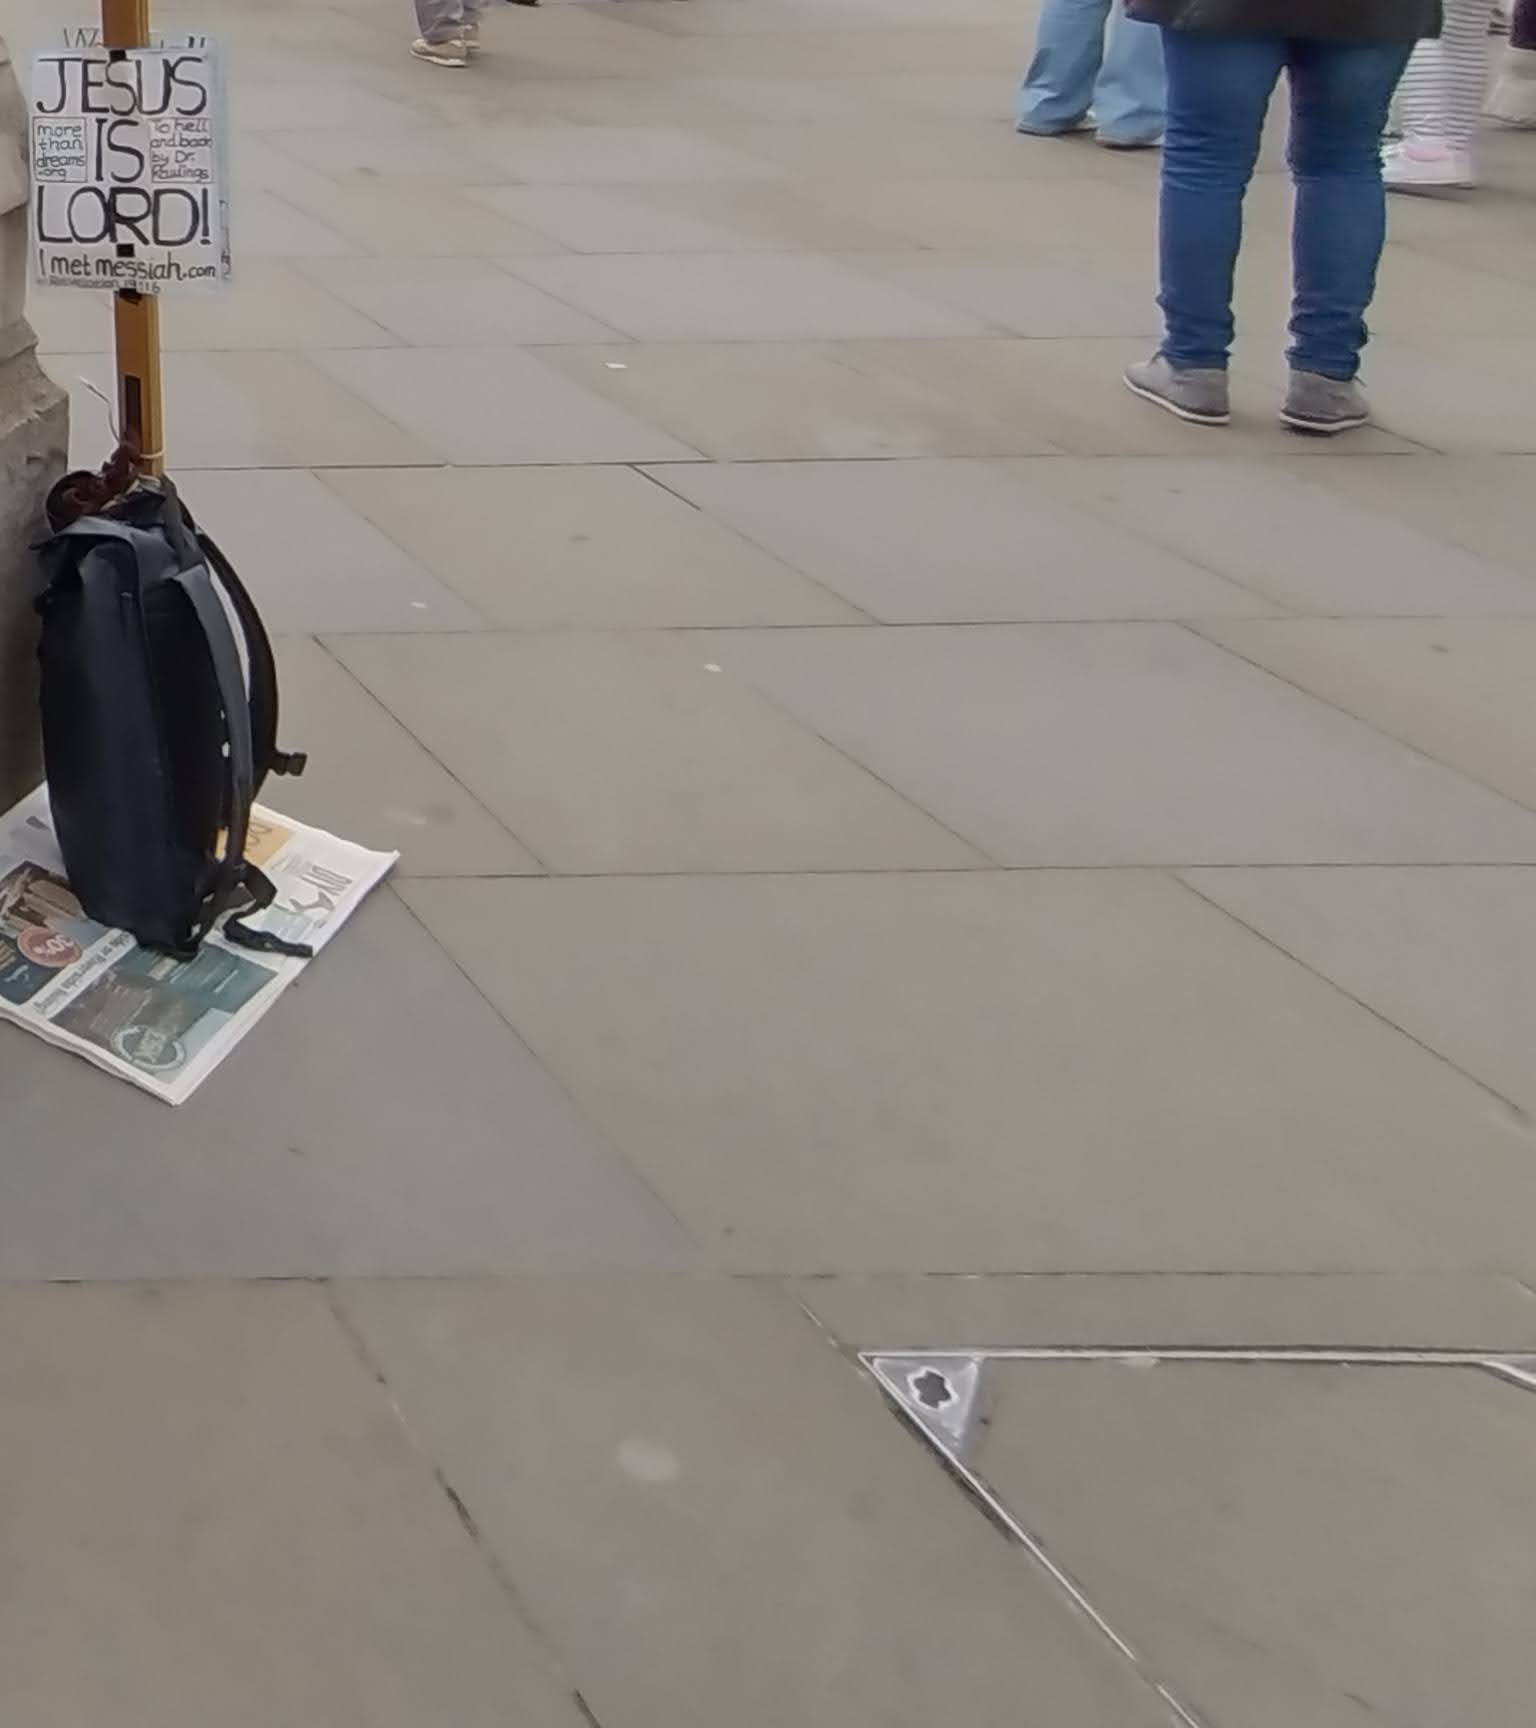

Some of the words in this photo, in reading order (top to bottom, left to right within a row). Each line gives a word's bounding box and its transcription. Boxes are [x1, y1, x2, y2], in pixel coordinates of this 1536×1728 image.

[36, 56, 207, 116] JESUS
[37, 124, 82, 137] more
[38, 138, 84, 151] than
[37, 153, 85, 167] dreams
[95, 118, 145, 183] IS
[37, 185, 211, 246] LORD!
